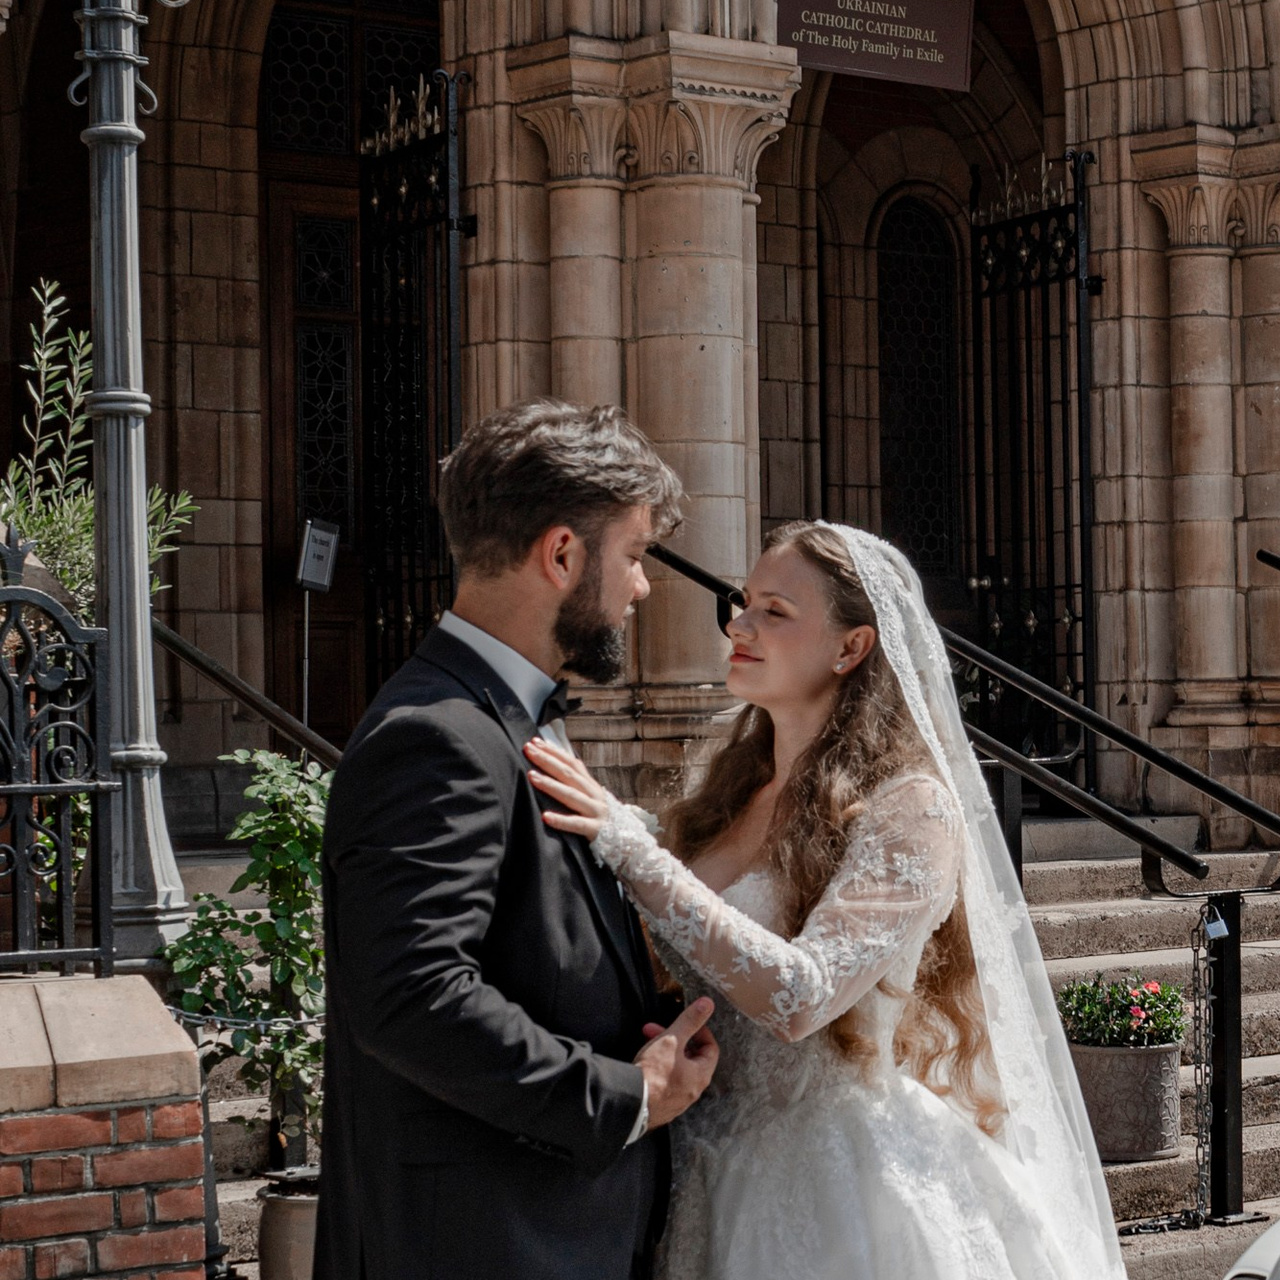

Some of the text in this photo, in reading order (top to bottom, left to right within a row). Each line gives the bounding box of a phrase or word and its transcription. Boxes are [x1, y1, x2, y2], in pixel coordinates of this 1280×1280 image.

[801, 10, 938, 43] CATHOLIC CATHEDRAL
[791, 28, 945, 64] of The Holy Family in Exile
